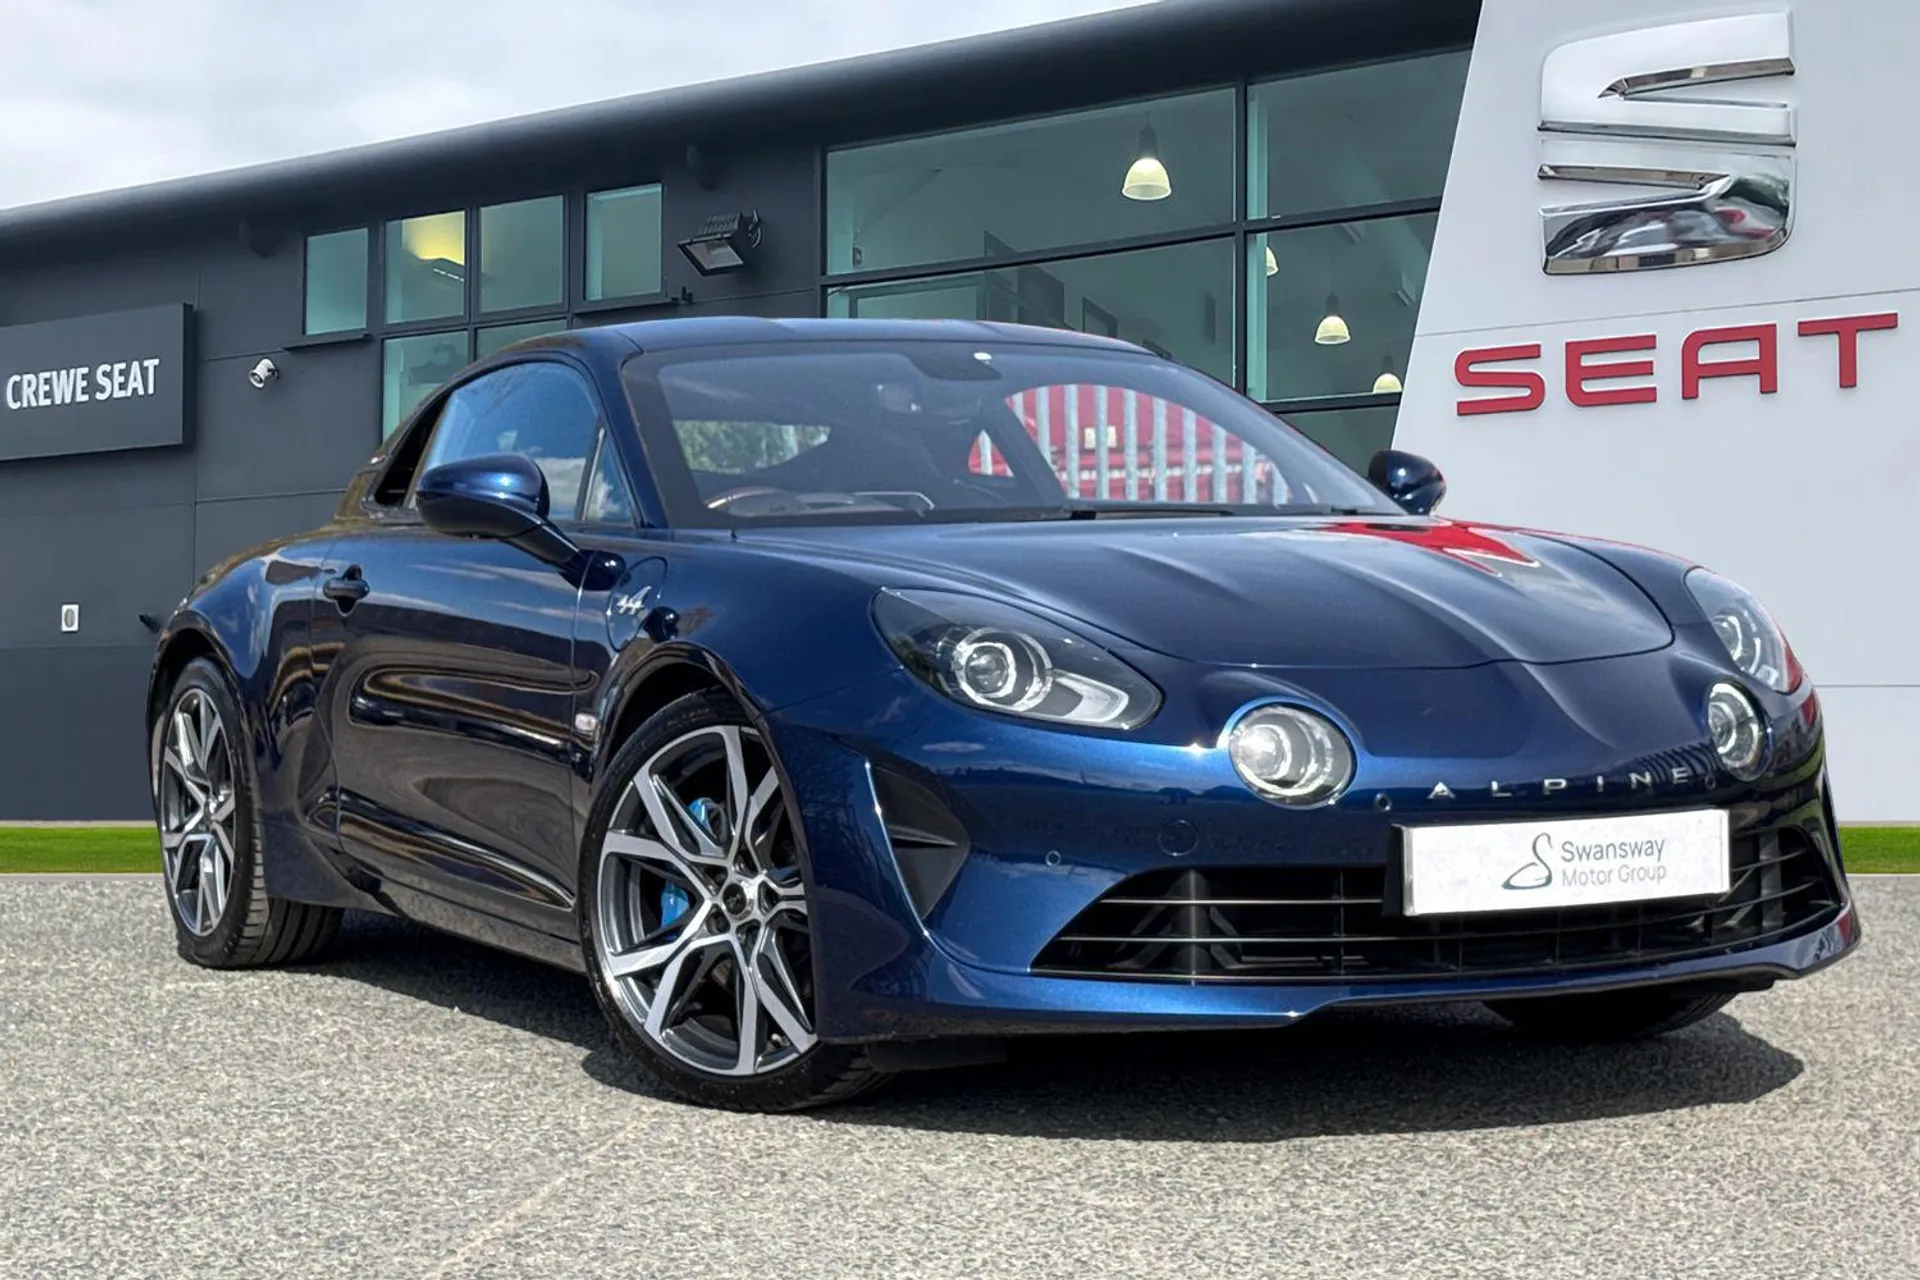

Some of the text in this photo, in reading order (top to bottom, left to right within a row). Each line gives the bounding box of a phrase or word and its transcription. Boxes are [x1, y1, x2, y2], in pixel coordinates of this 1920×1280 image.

[1454, 312, 1899, 416] SEAT
[6, 358, 160, 410] CREWE SEAT
[1428, 766, 1690, 799] ALPINE
[1561, 837, 1666, 864] Swansway
[1561, 864, 1667, 887] Motor Group
